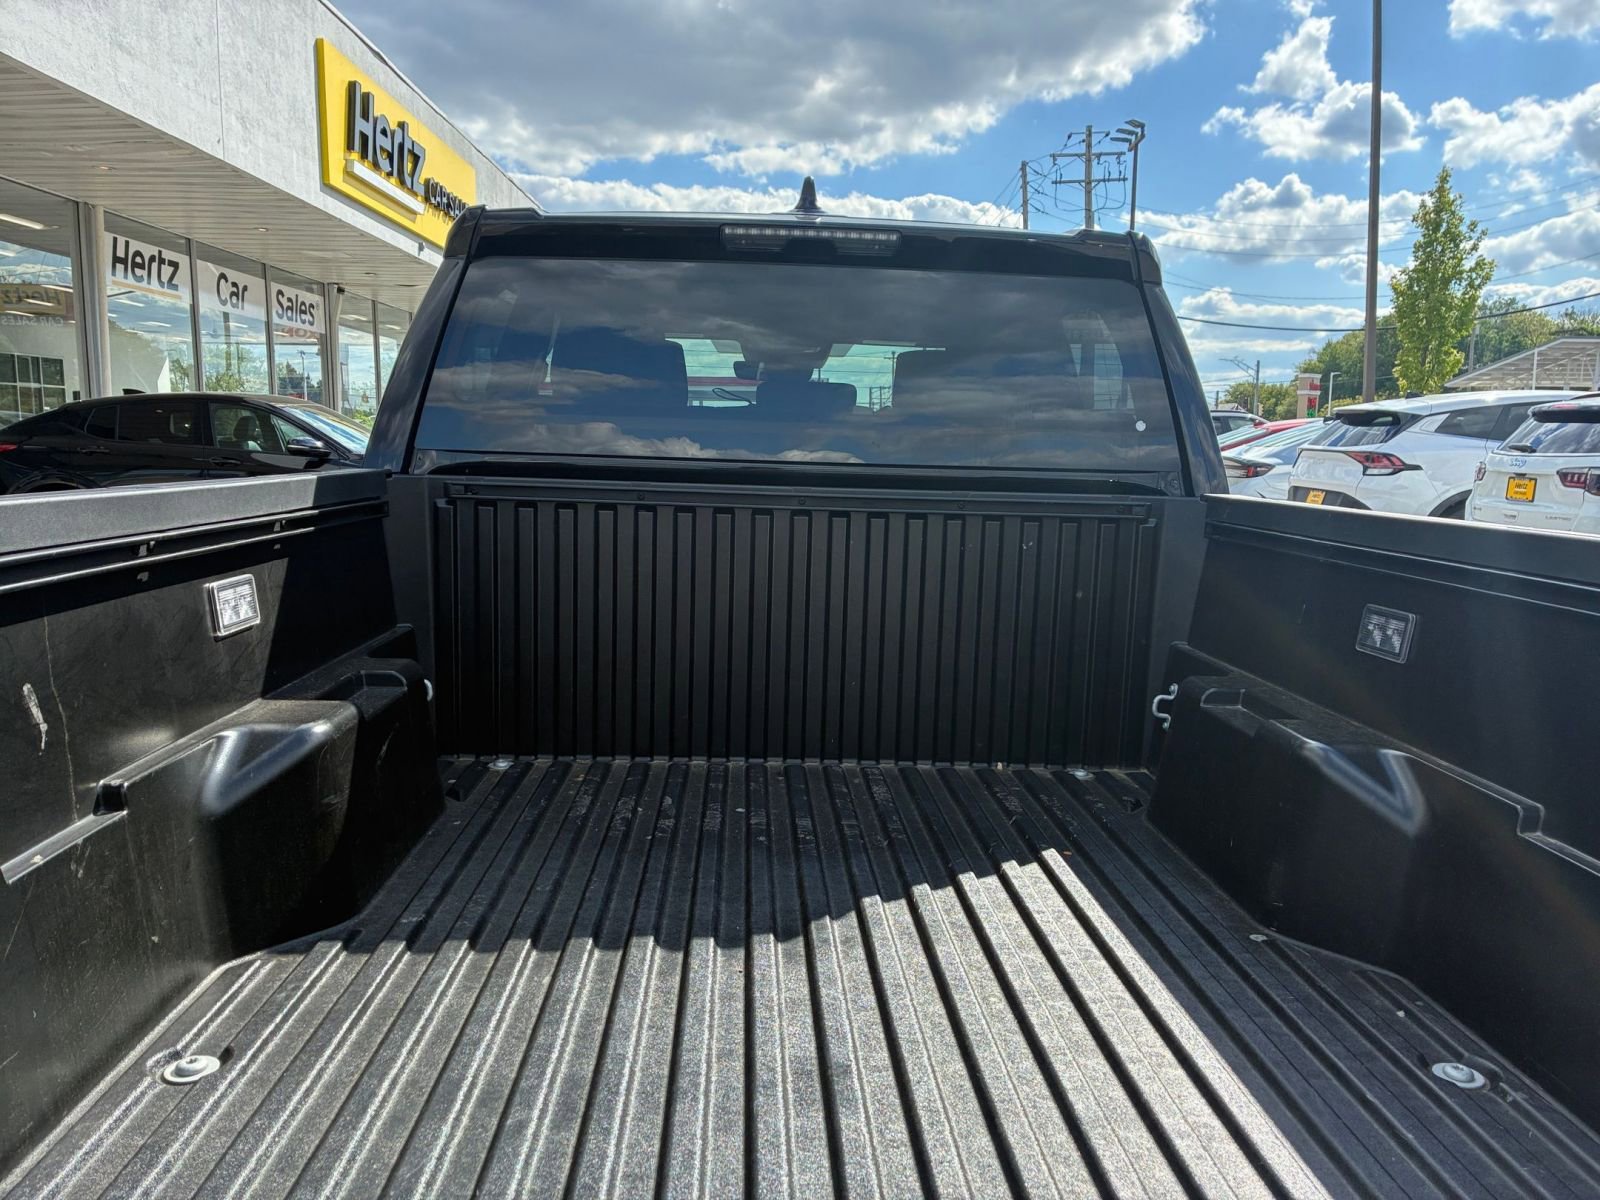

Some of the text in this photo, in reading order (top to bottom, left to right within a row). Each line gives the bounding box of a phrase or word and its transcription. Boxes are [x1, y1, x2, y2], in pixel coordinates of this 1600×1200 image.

[347, 80, 425, 195] Hertz
[424, 177, 469, 218] CAR SAL
[111, 236, 315, 327] Hertz Car Sales
